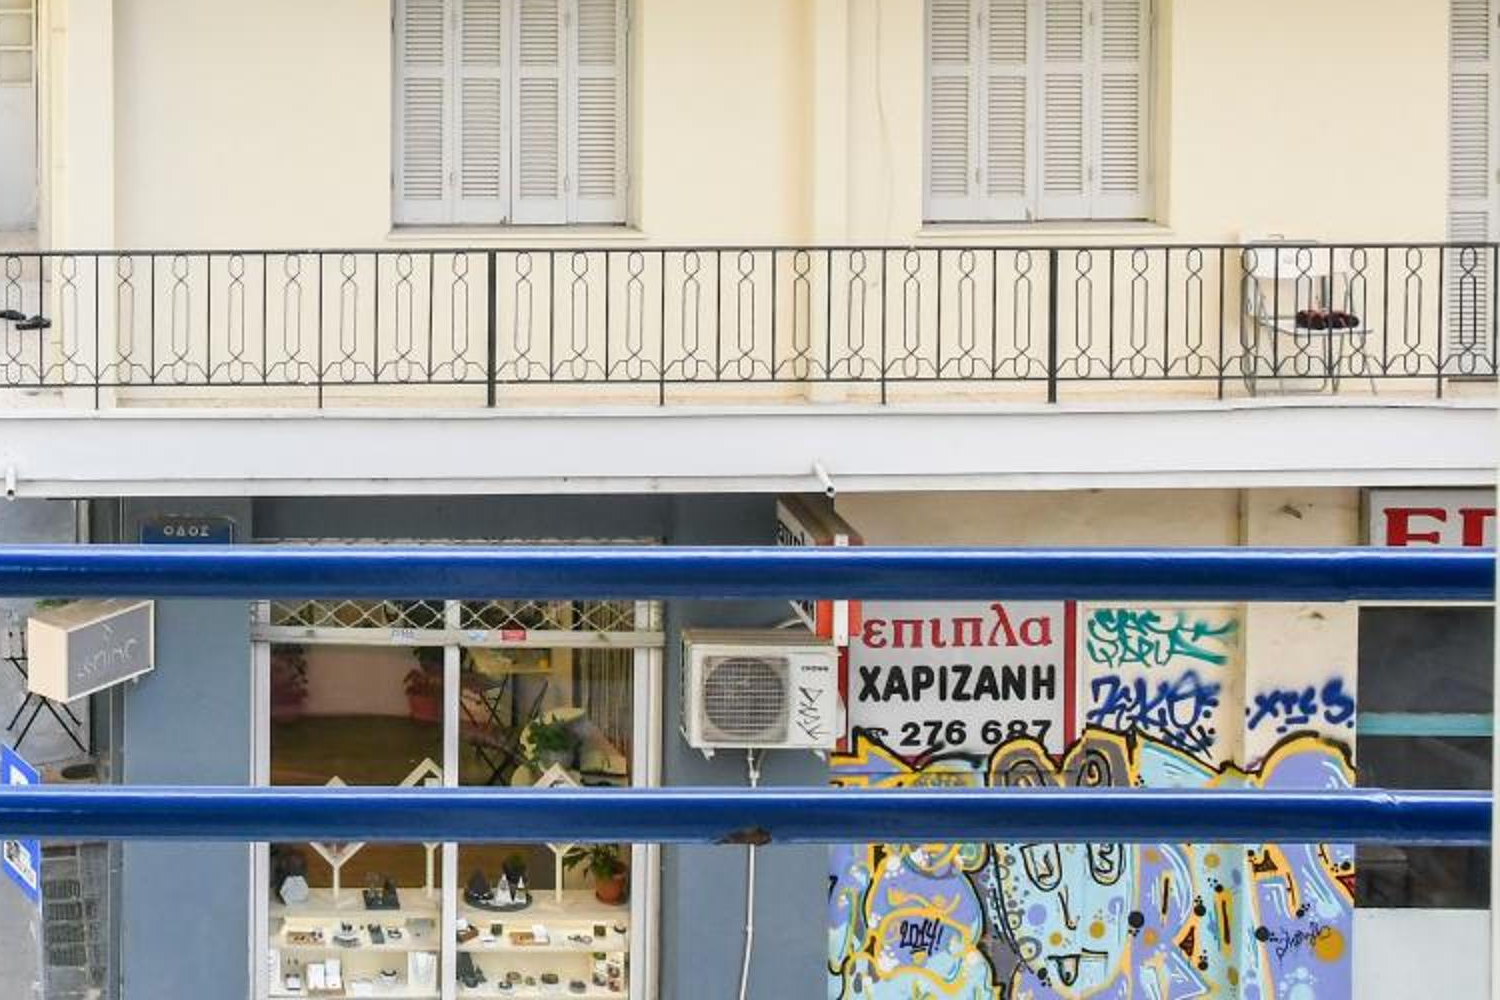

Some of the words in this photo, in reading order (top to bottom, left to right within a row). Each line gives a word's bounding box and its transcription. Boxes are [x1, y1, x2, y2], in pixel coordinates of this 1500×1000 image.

[163, 525, 209, 537] ΟΔΟΣ
[862, 603, 1053, 648] επιπλα
[858, 664, 1056, 702] ΧΑΡΙΖΑΝΗ
[900, 720, 967, 746] 276
[981, 719, 1052, 746] 687
